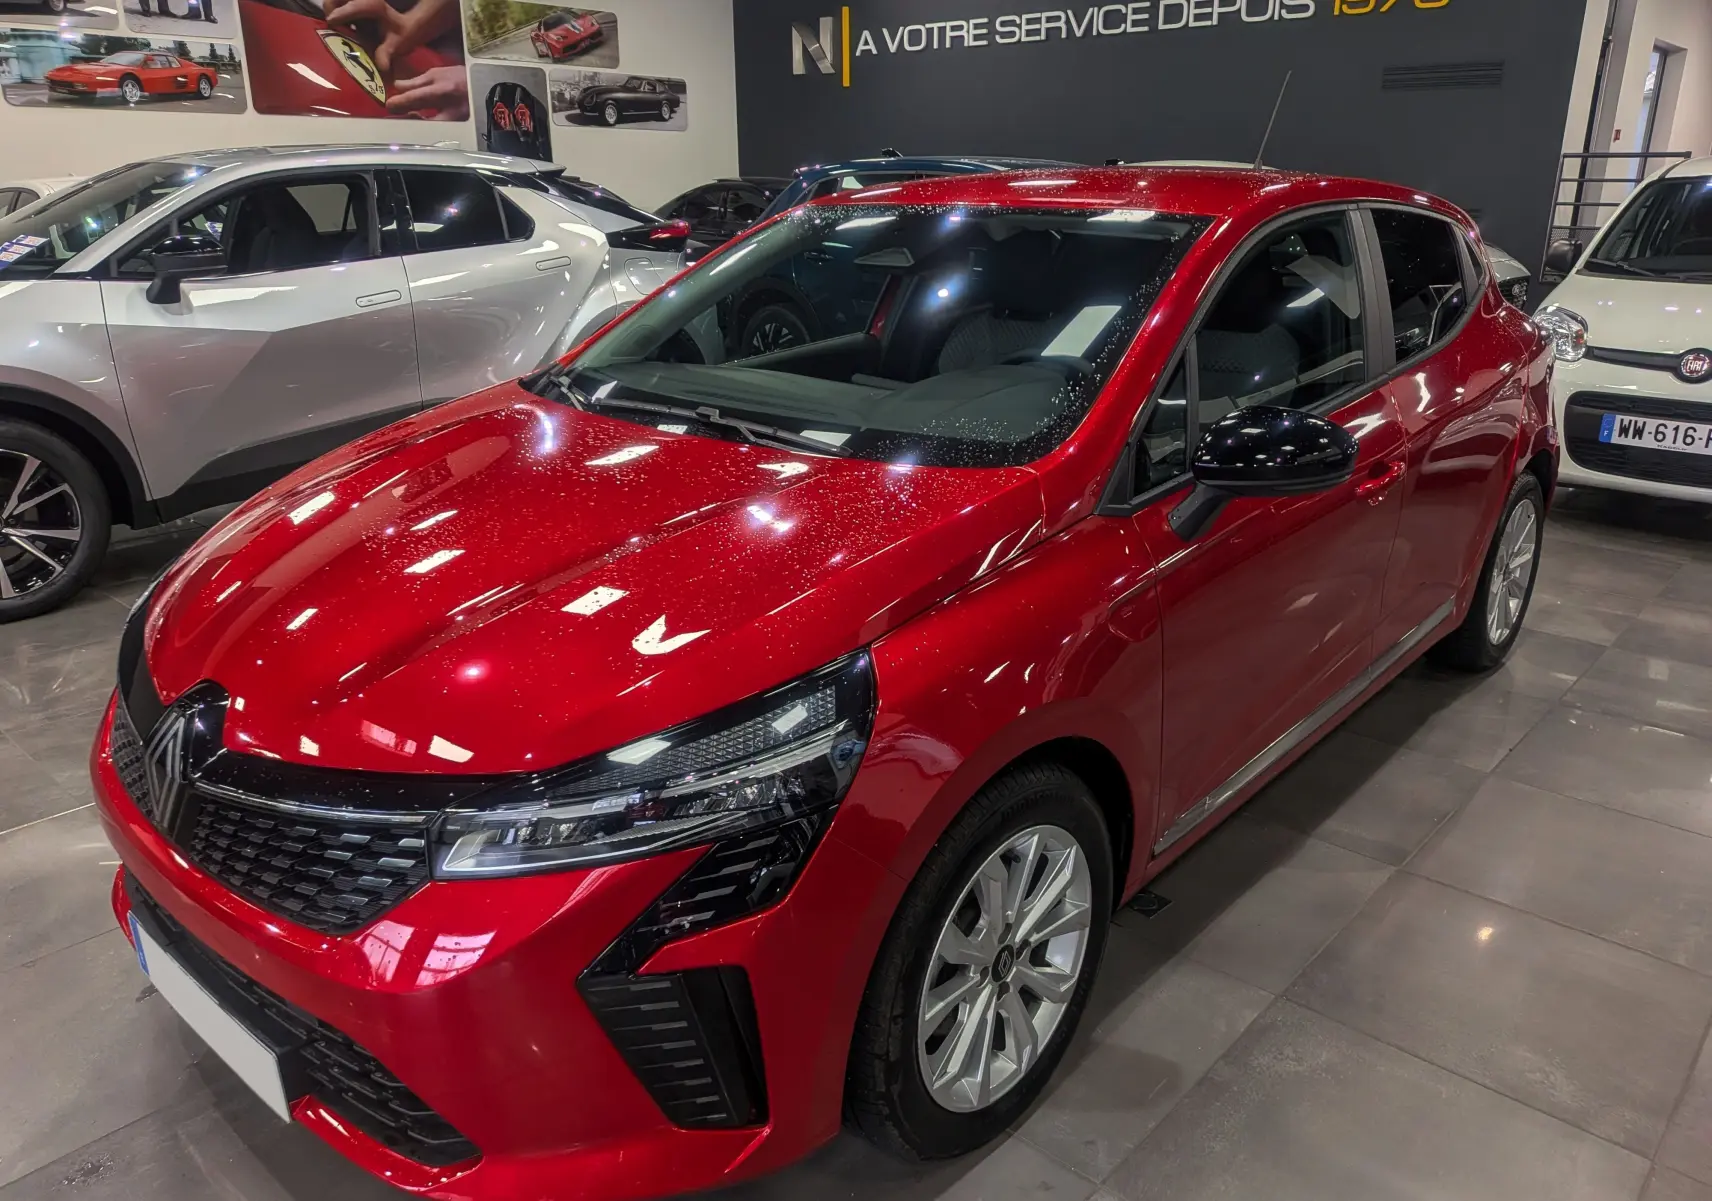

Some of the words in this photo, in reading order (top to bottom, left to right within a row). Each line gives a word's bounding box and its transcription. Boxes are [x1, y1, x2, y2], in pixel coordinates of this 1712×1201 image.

[855, 30, 878, 57] A
[882, 17, 989, 54] VOTRE
[995, 1, 1151, 44] SERVICE
[1158, 0, 1316, 30] DEPUIS
[1687, 359, 1704, 371] FIAT
